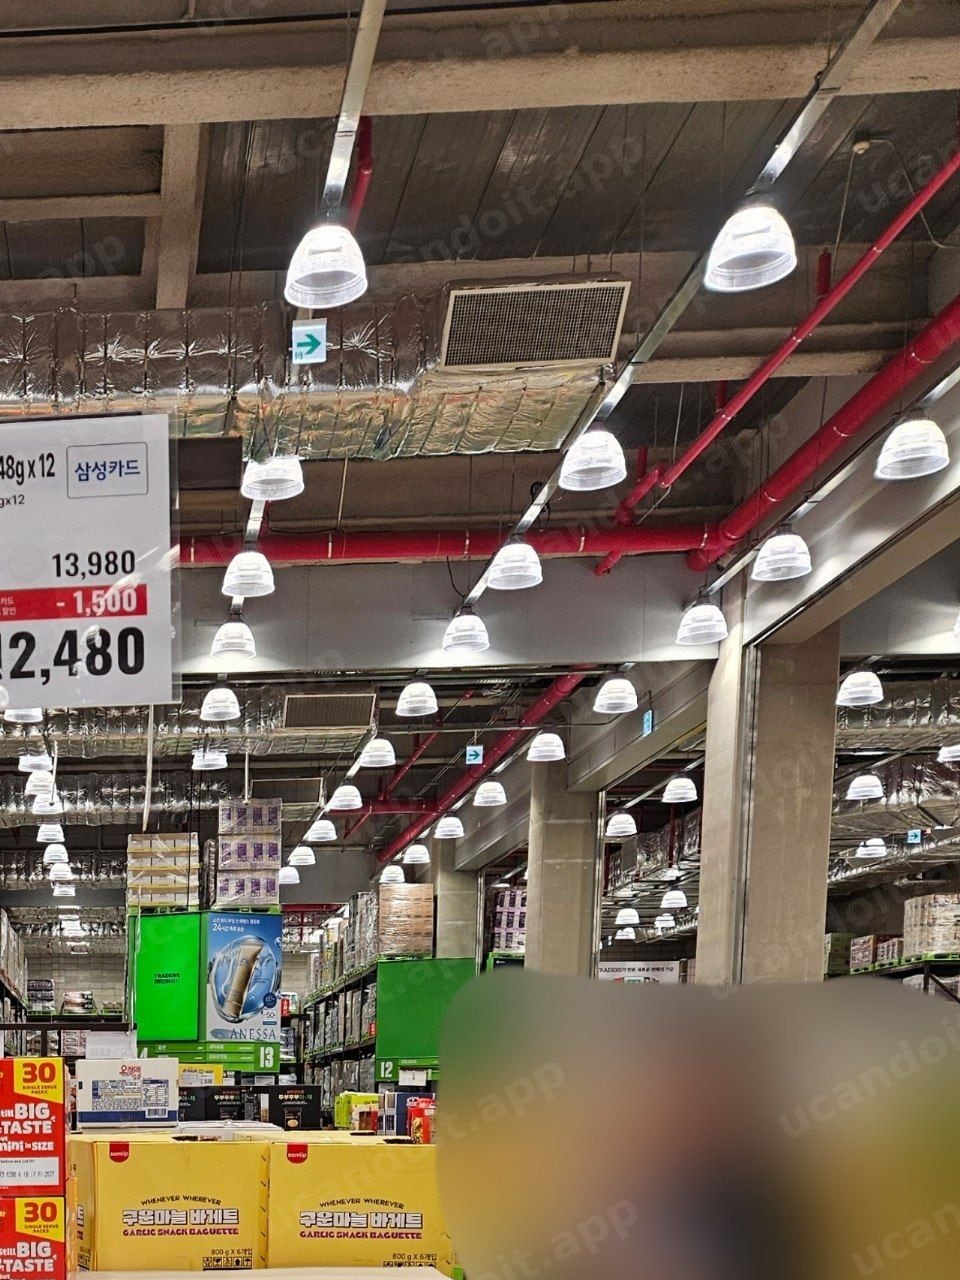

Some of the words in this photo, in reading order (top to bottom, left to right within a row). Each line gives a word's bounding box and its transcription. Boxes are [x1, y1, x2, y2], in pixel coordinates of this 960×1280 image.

[39, 453, 55, 478] 12
[74, 459, 141, 483] 삼성카드
[52, 549, 136, 581] 13,980
[73, 588, 137, 616] 1,500
[230, 1028, 277, 1040] ANESSA
[259, 1046, 274, 1069] 13
[22, 1062, 56, 1084] 30
[380, 1061, 393, 1078] 12
[14, 1103, 50, 1120] BIG
[2, 1121, 53, 1135] TASTE
[32, 1142, 54, 1151] SIZE
[140, 1195, 181, 1206] WHENEVER
[182, 1195, 222, 1206] WHEREVER
[319, 1197, 361, 1208] WHENEVER
[363, 1197, 404, 1209] WHEREVER
[24, 1201, 58, 1223] 30
[122, 1208, 187, 1226] 구운마늘
[189, 1208, 239, 1226] 바게트
[299, 1211, 368, 1229] 구운마늘
[370, 1211, 423, 1229] 바게트
[122, 1228, 156, 1237] GARLIC
[157, 1228, 189, 1237] SNACK
[189, 1227, 239, 1236] BAGUETTE
[299, 1231, 335, 1239] GARLIC
[336, 1231, 368, 1239] SNACK
[369, 1231, 422, 1240] BAGUETTE
[16, 1241, 52, 1258] BIG
[3, 1259, 54, 1273] TASTE
